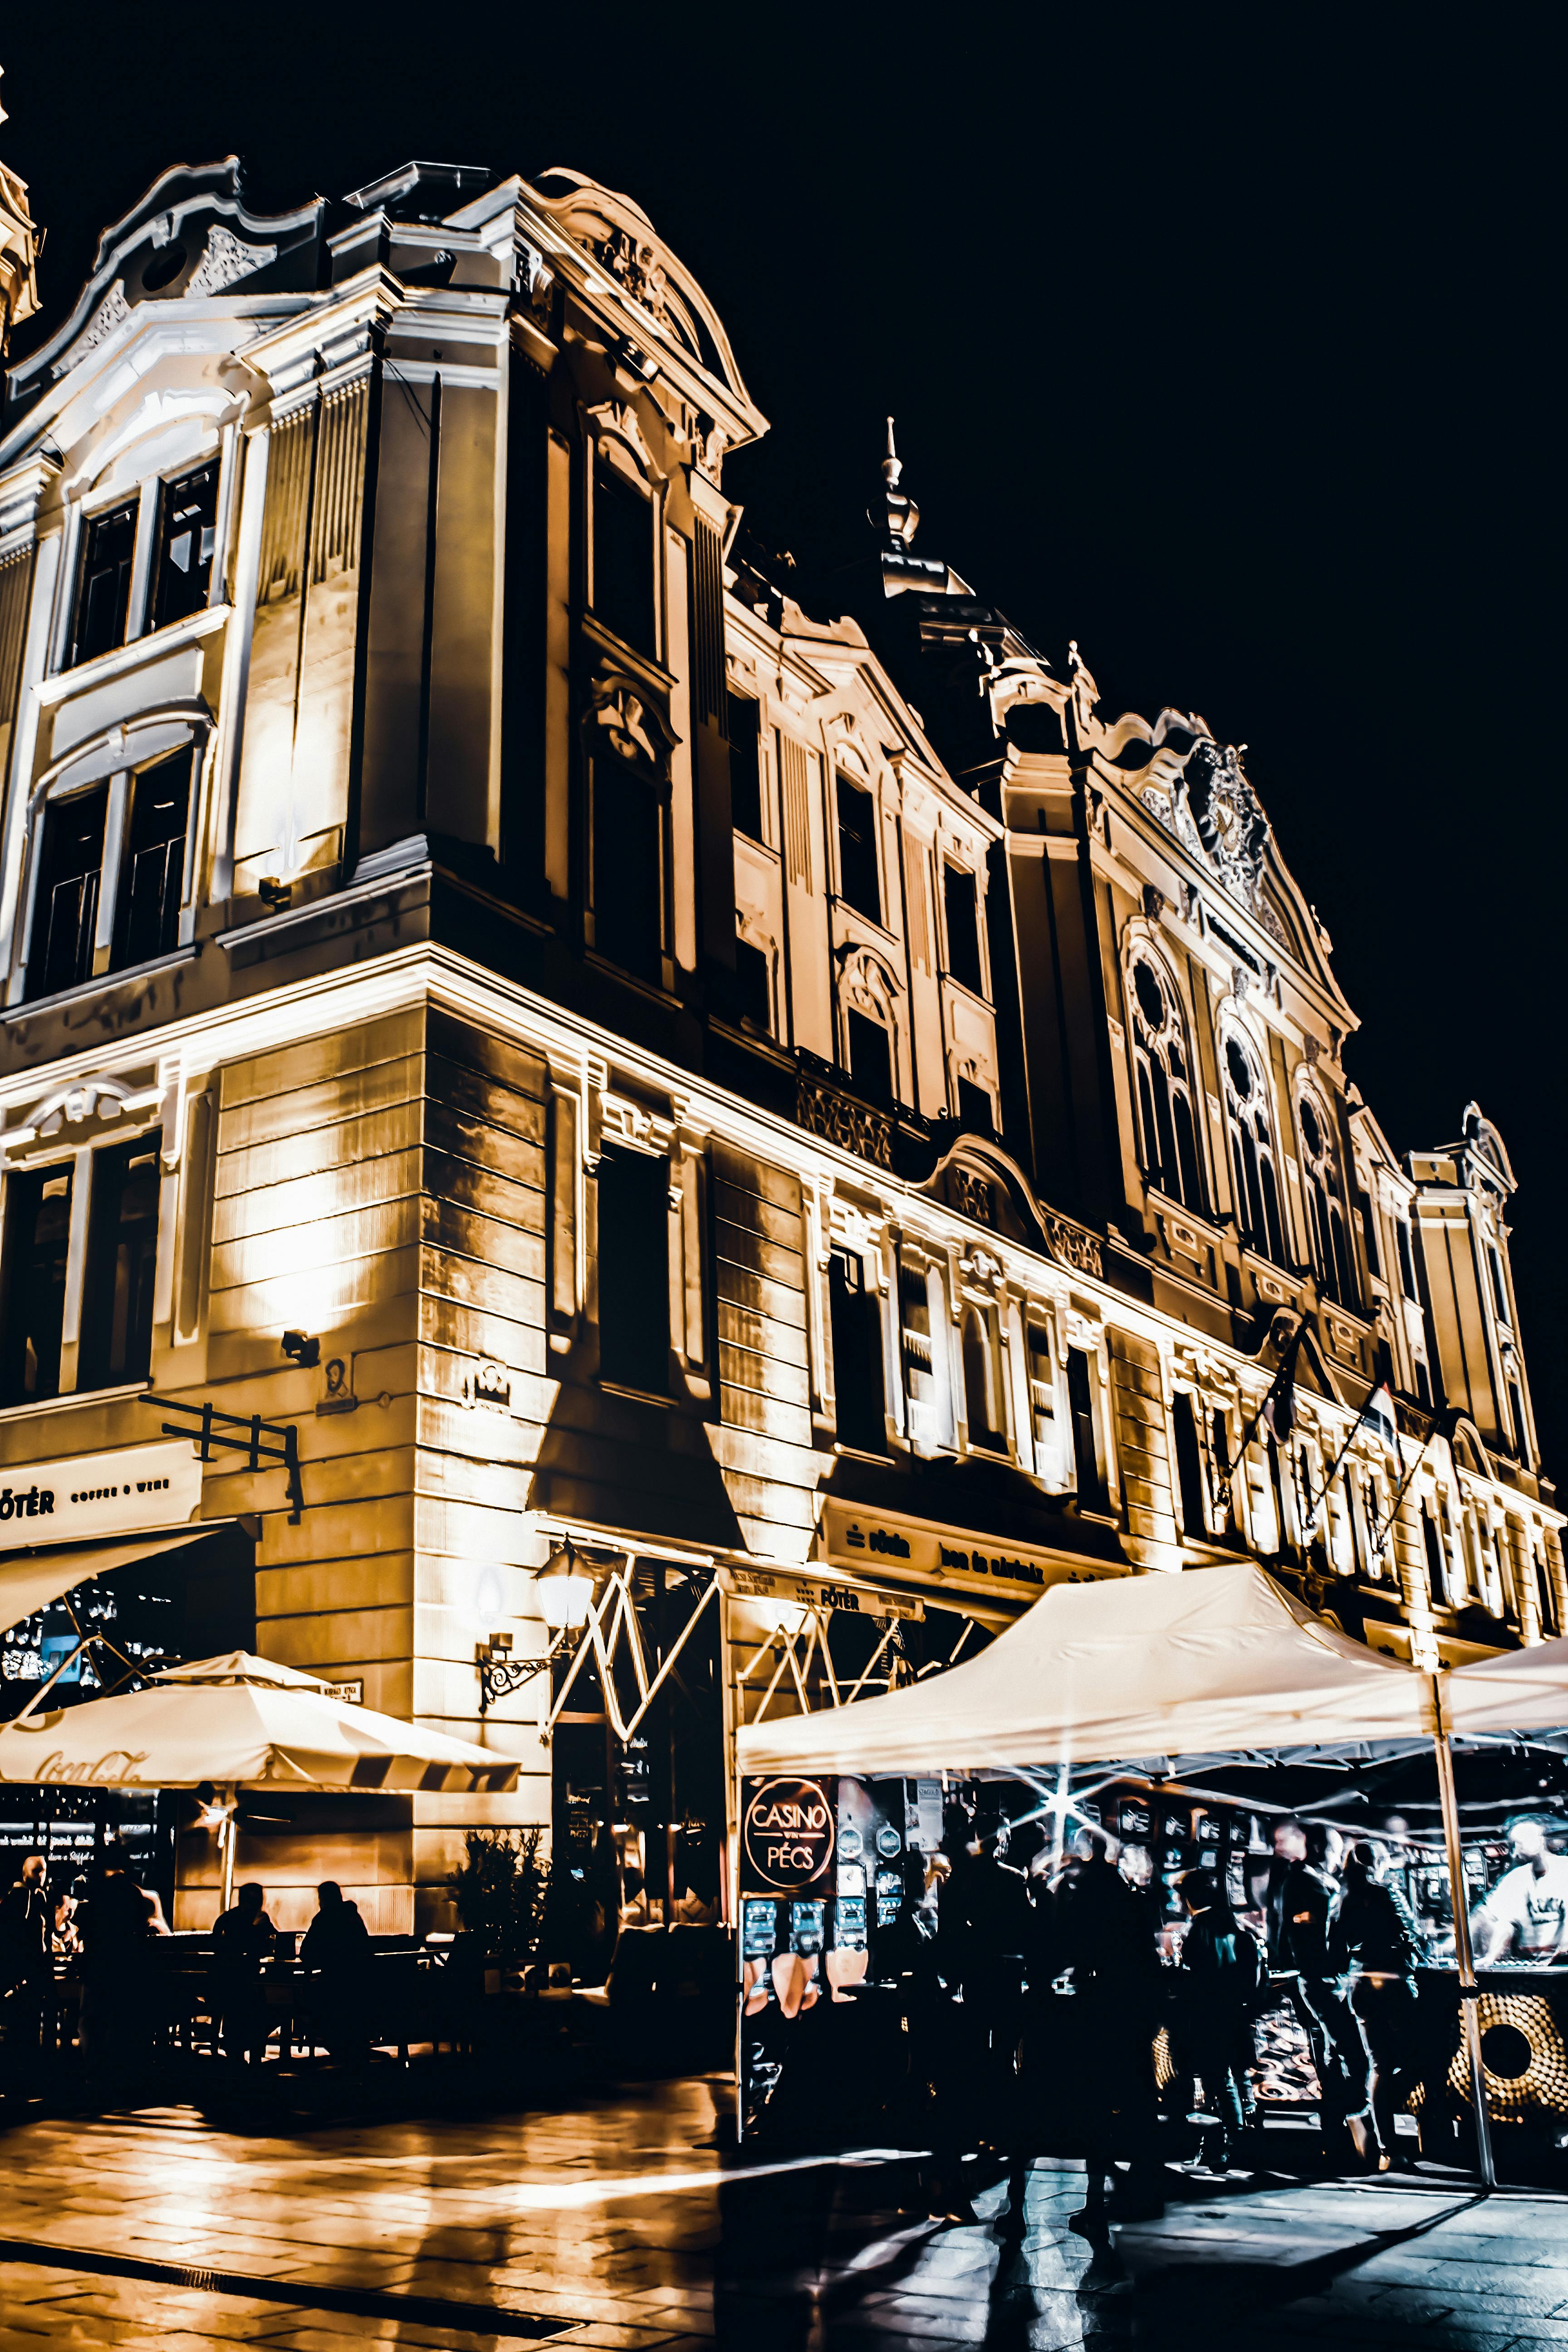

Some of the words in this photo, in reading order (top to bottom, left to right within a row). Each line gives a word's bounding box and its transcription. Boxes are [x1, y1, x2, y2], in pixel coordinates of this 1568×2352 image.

[820, 1585, 859, 1611] FŐTÉR
[752, 1804, 827, 1829] CASINO
[768, 1842, 814, 1869] PÉCS
